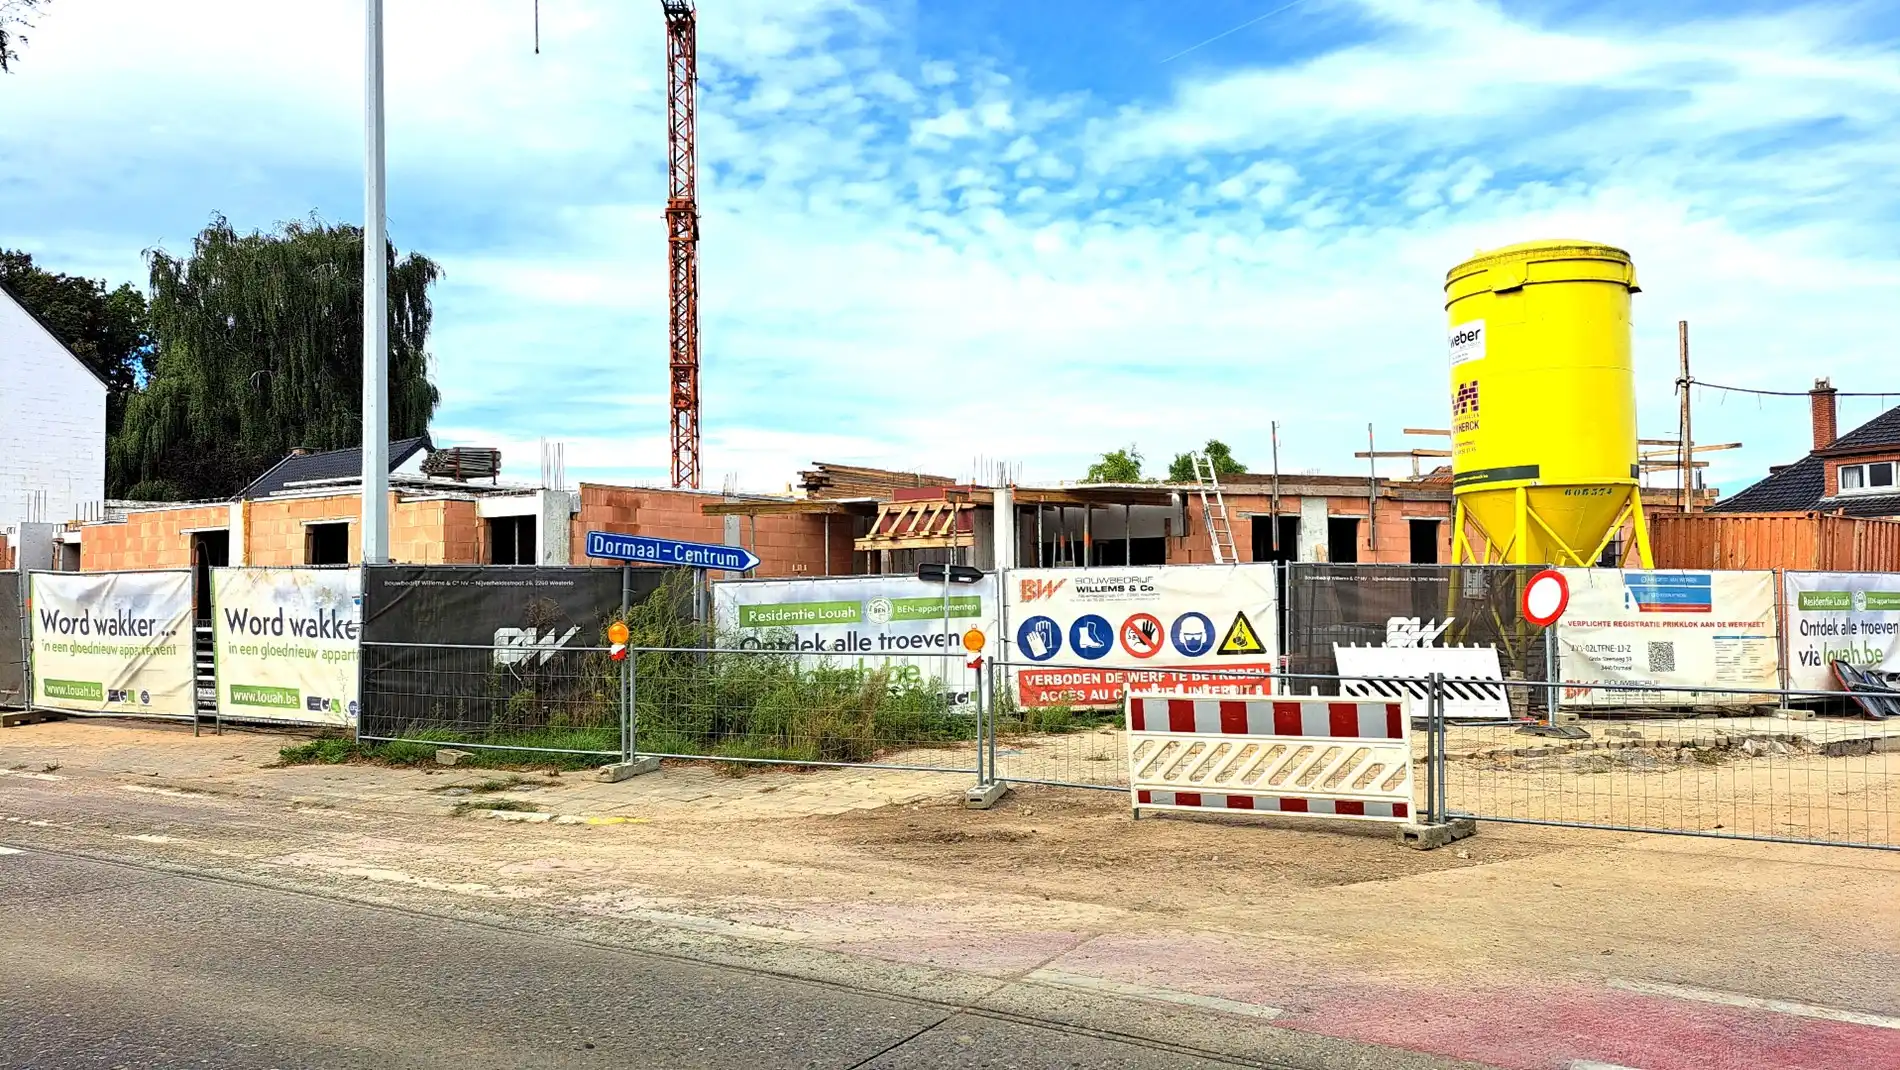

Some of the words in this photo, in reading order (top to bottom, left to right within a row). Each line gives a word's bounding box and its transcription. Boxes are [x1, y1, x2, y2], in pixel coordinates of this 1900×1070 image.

[1075, 576, 1154, 584] BOUWBEDRIJF
[40, 608, 90, 636] Word
[93, 609, 156, 637] wakker
[224, 607, 284, 637] Word
[748, 608, 816, 622] Residentie
[819, 606, 856, 619] Louah
[1800, 618, 1839, 636] Ontdek
[1841, 617, 1857, 635] alle
[1861, 620, 1899, 635] troeven
[41, 639, 51, 652] in
[52, 642, 68, 653] een
[70, 640, 118, 658] gloednieuw
[835, 631, 872, 652] alle
[878, 632, 961, 651] troeven
[228, 642, 238, 655] in
[239, 645, 259, 656] een
[260, 642, 319, 660] gloednieuw
[1799, 644, 1822, 666] via
[1823, 640, 1884, 665] louah.be
[1025, 672, 1101, 686] VERBODEN
[1105, 672, 1123, 684] DE
[1127, 671, 1166, 683] WERF
[1171, 671, 1188, 681] TE
[46, 684, 101, 699] www.louah.be
[233, 690, 298, 705] www.louah.be
[1039, 686, 1086, 702] ACCÈS
[1090, 689, 1109, 700] AU
